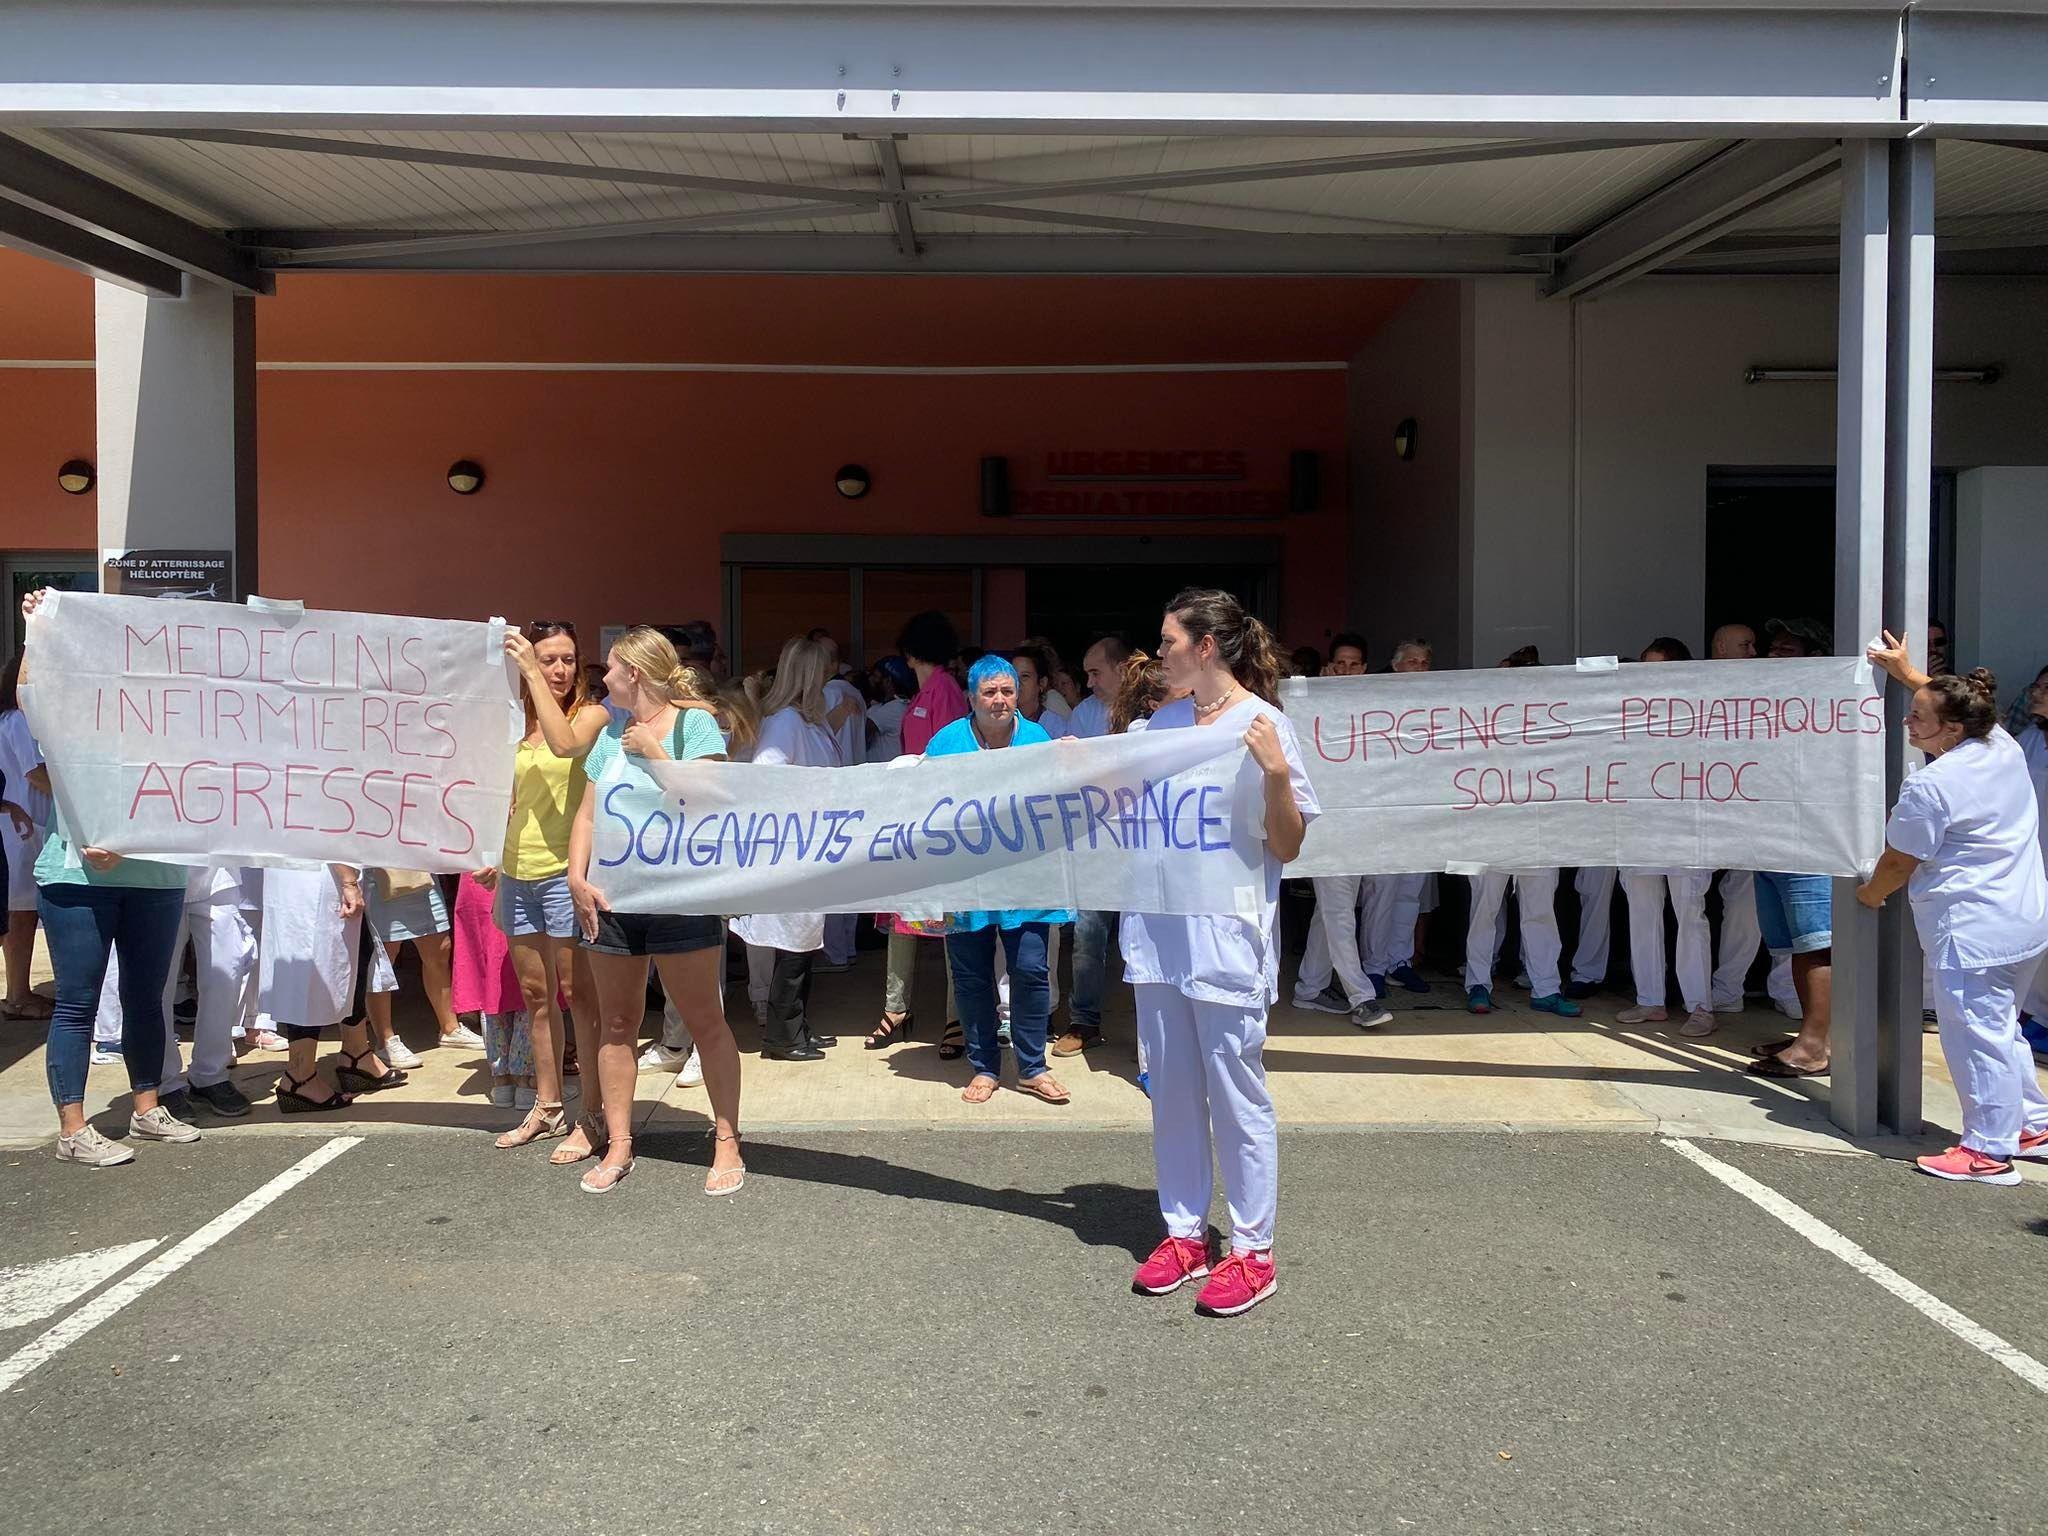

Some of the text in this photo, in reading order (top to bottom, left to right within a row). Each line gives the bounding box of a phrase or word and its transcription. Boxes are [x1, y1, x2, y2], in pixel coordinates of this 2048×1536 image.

[1048, 451, 1248, 474] URGENCES
[109, 560, 225, 568] ZONE D' ATTERRISSAGE
[130, 569, 205, 579] HÉLICOPTÈRE
[125, 624, 427, 695] MEDECINS
[97, 688, 457, 759] INFIRMIERES
[1315, 697, 1882, 763] URGENCES PEDIATRIQUES
[129, 761, 475, 855] AGRESSES
[1452, 761, 1760, 811] SOUS LE CHOC
[869, 821, 918, 862] EN
[922, 779, 1231, 855] SOUFFRANCE
